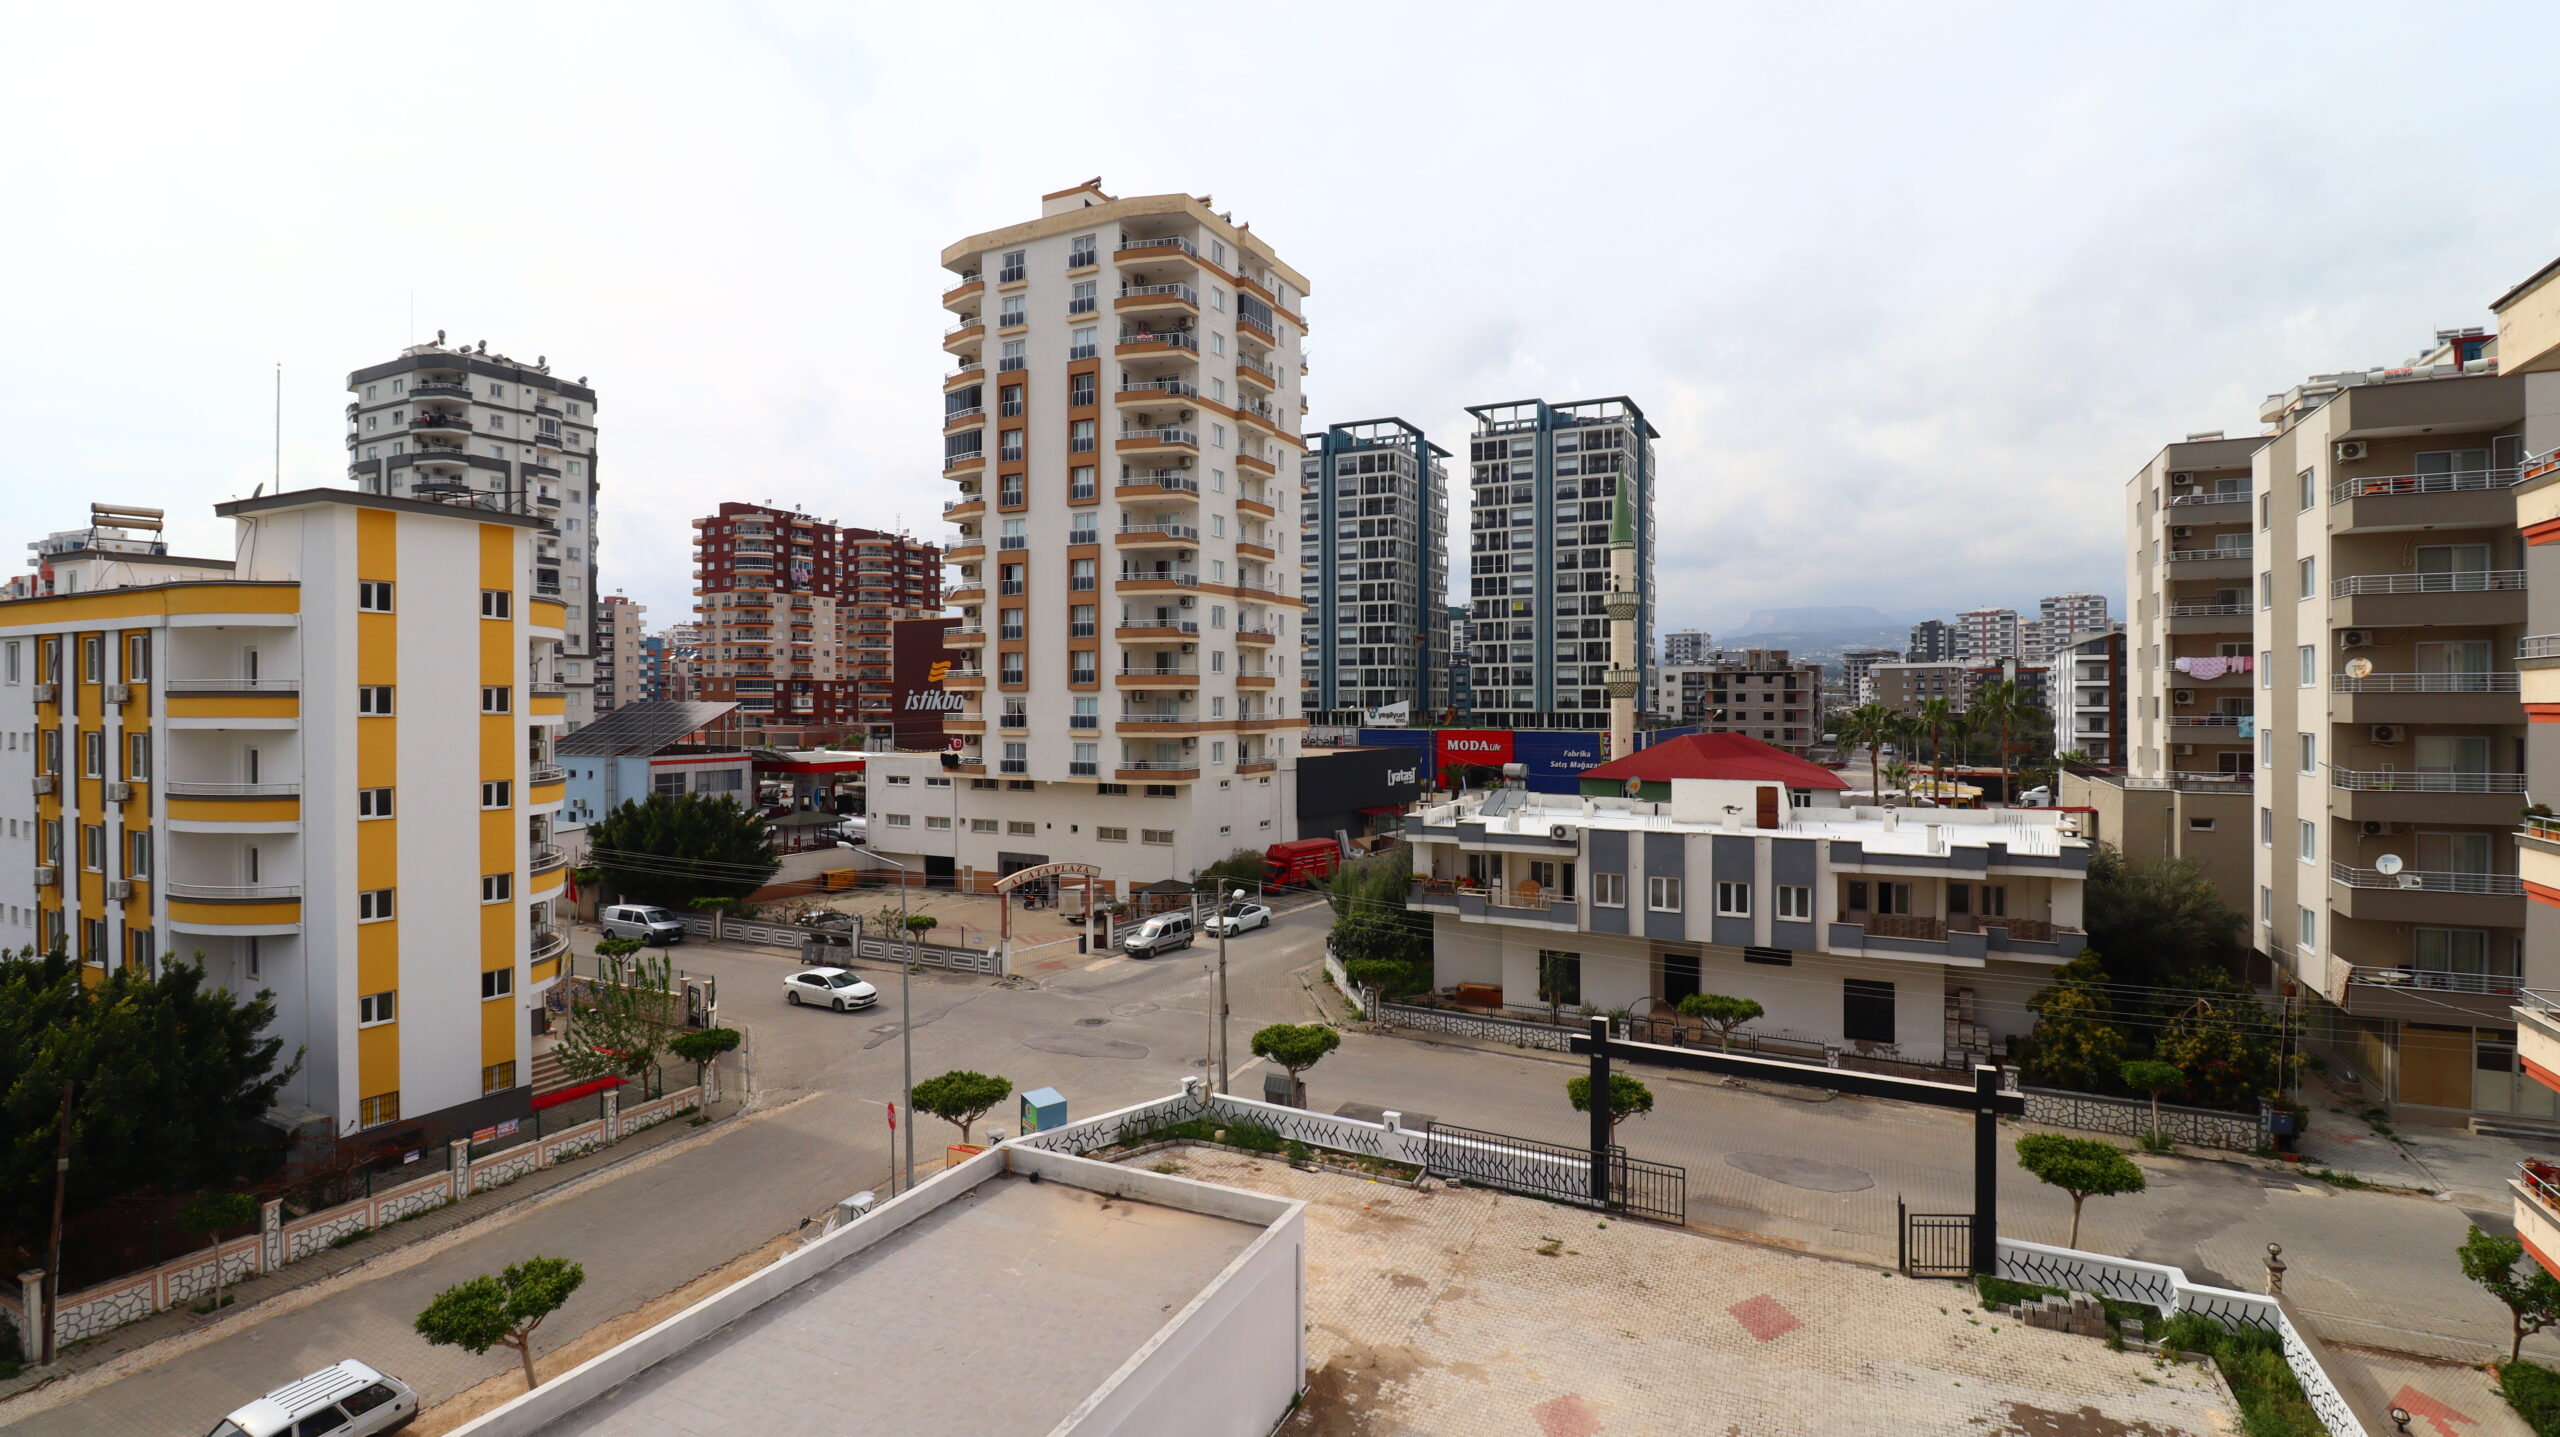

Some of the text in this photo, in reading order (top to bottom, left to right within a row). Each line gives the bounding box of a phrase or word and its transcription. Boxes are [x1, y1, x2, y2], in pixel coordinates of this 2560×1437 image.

[904, 689, 964, 711] istikba
[1563, 750, 1591, 758] Fabrika
[1569, 761, 1601, 770] Mağaza
[1010, 864, 1090, 887] ALATA PLAZA
